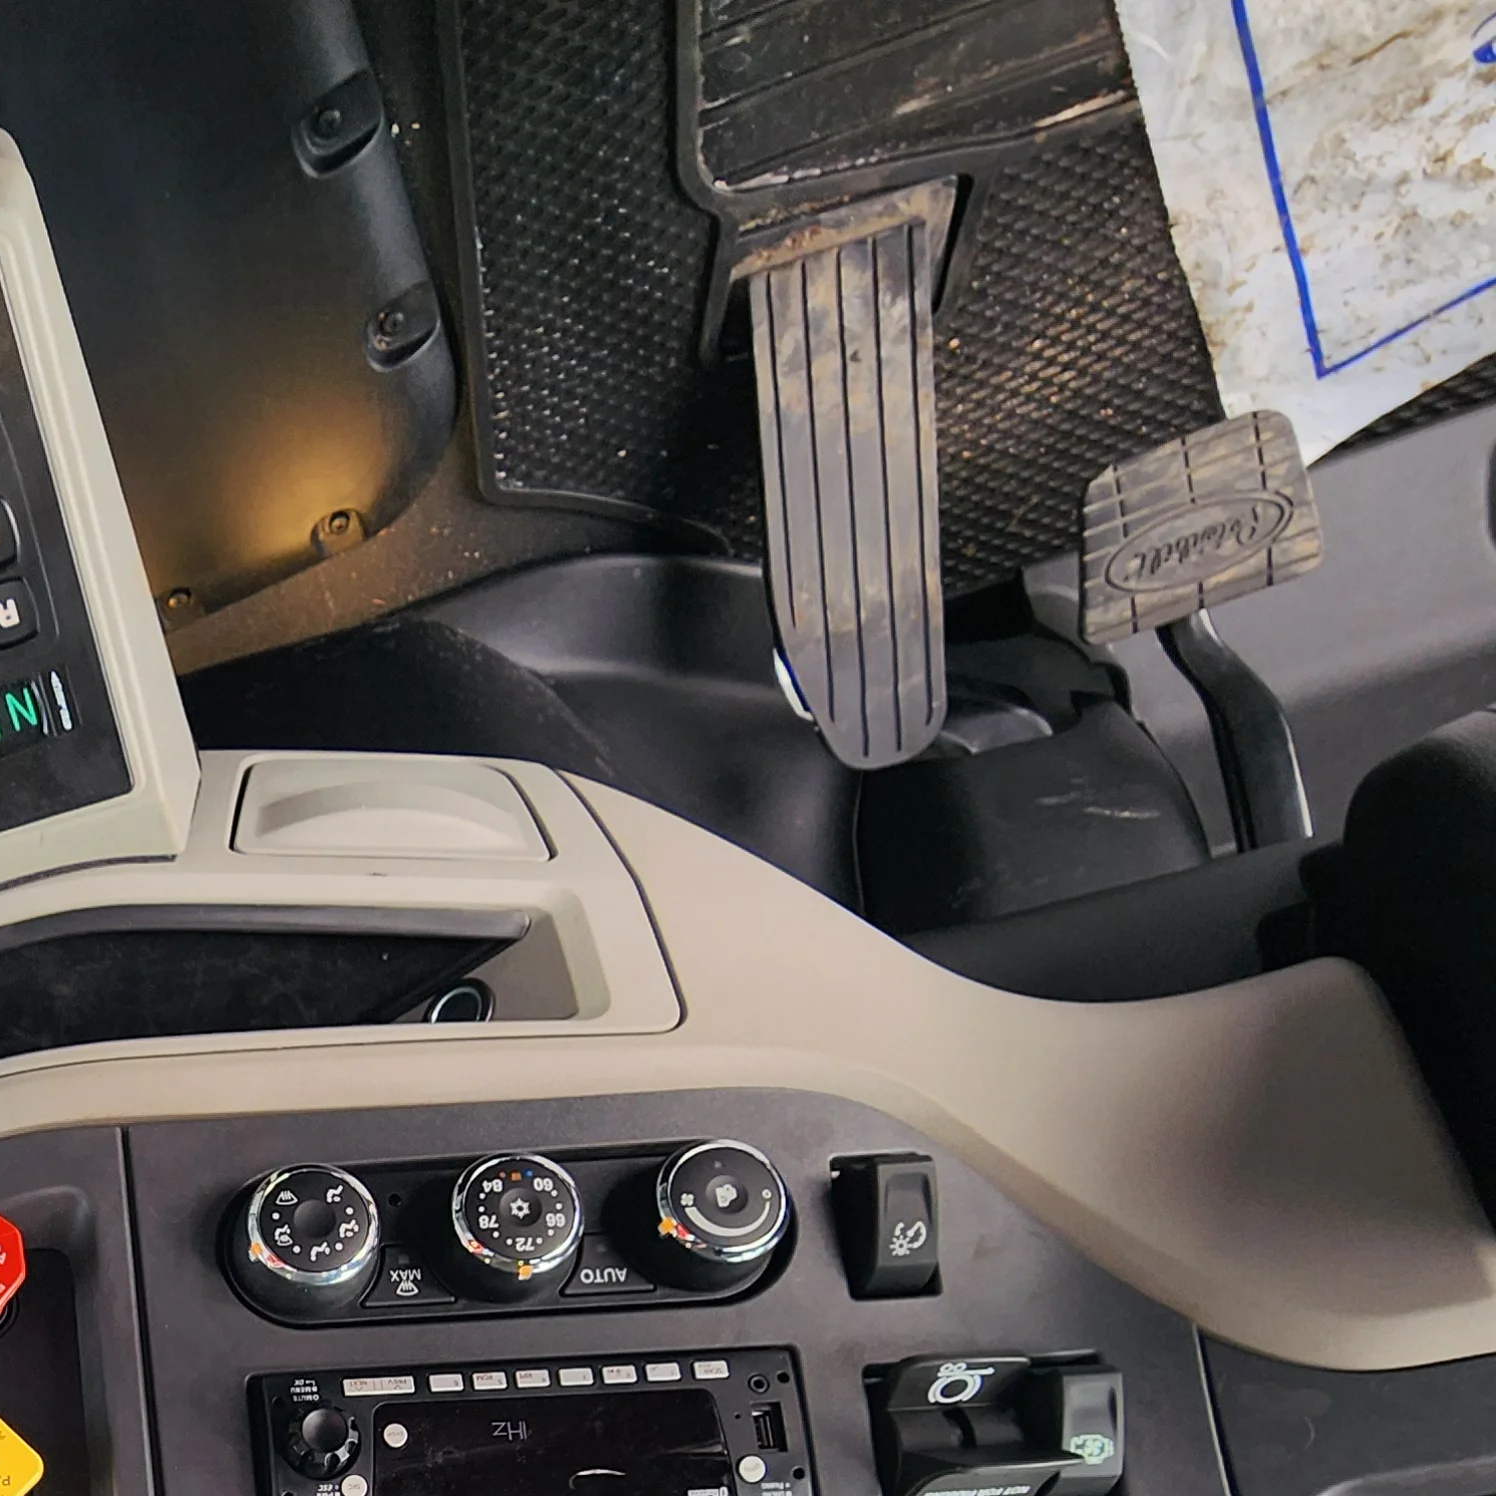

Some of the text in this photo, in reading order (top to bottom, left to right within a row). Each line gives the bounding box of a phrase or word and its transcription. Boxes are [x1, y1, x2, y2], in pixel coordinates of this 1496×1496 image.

[482, 1179, 502, 1192] 84
[534, 1178, 553, 1190] 60
[478, 1214, 499, 1229] 78
[546, 1213, 566, 1228] 66
[516, 1238, 534, 1252] 72
[389, 1268, 421, 1282] MAX
[580, 1267, 627, 1284] AUTO
